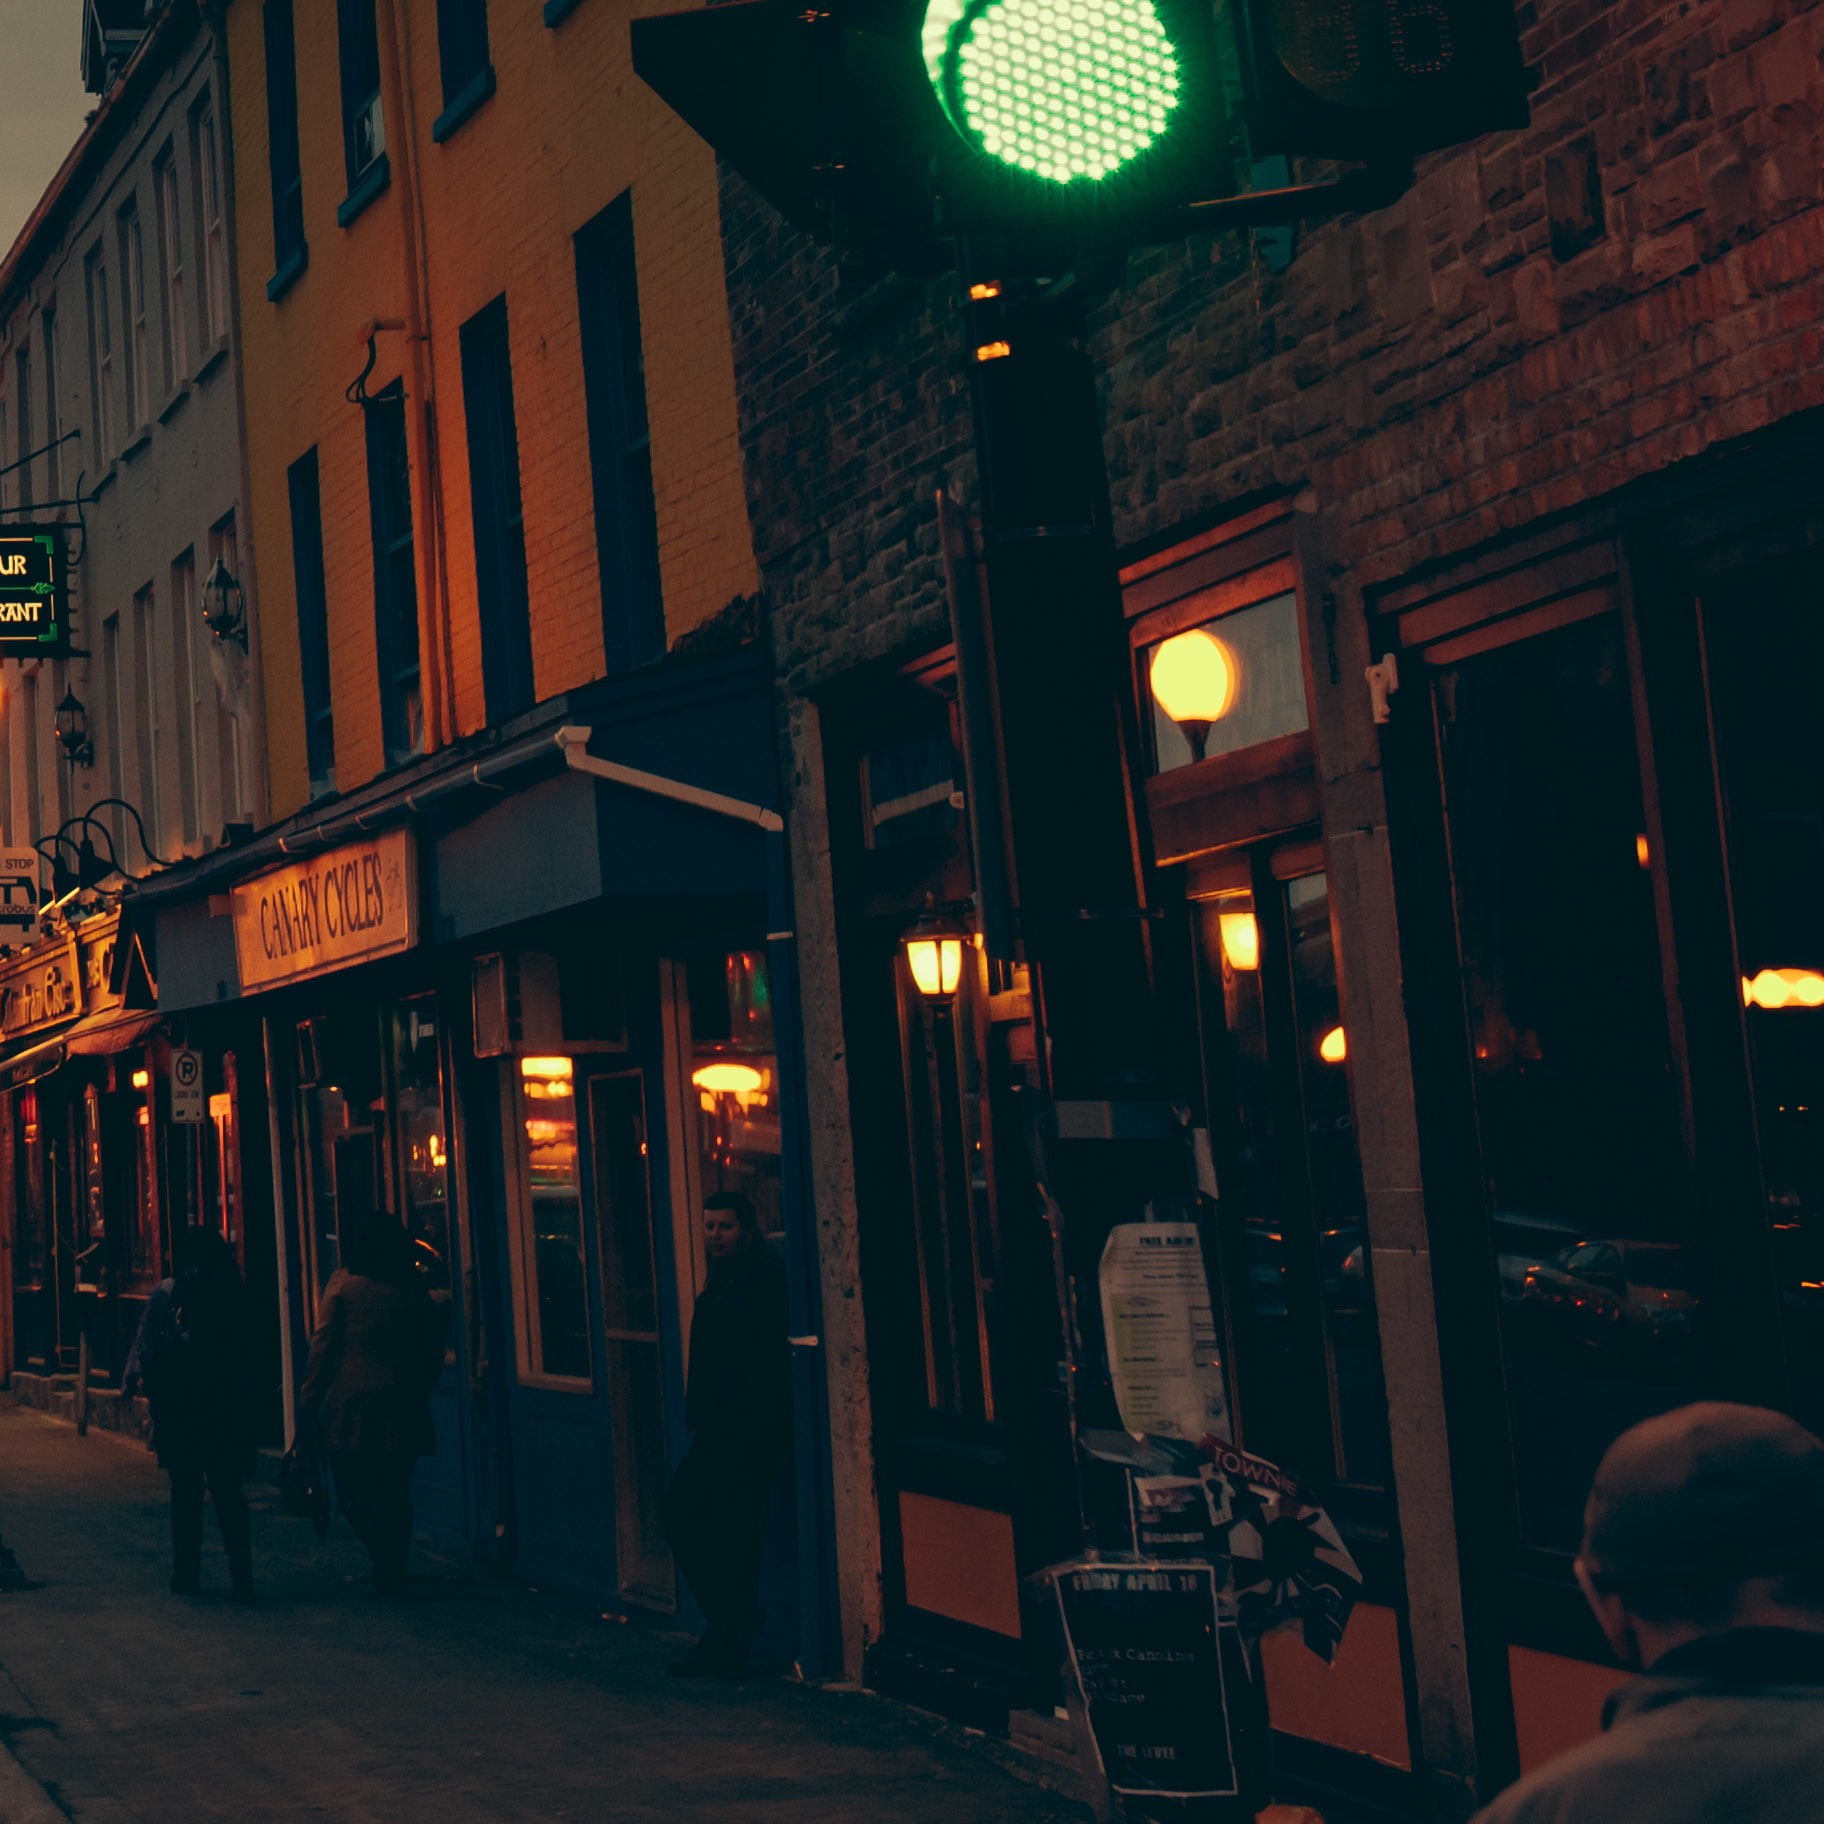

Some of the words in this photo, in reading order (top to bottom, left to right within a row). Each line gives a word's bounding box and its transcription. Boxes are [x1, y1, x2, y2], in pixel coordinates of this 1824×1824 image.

[6, 859, 34, 869] STOP
[260, 873, 321, 960] CANARY
[324, 851, 384, 939] CYCLES
[1212, 1446, 1297, 1498] TOWNIE
[1072, 1574, 1120, 1591] FRIDAY
[1126, 1574, 1172, 1591] APRIL
